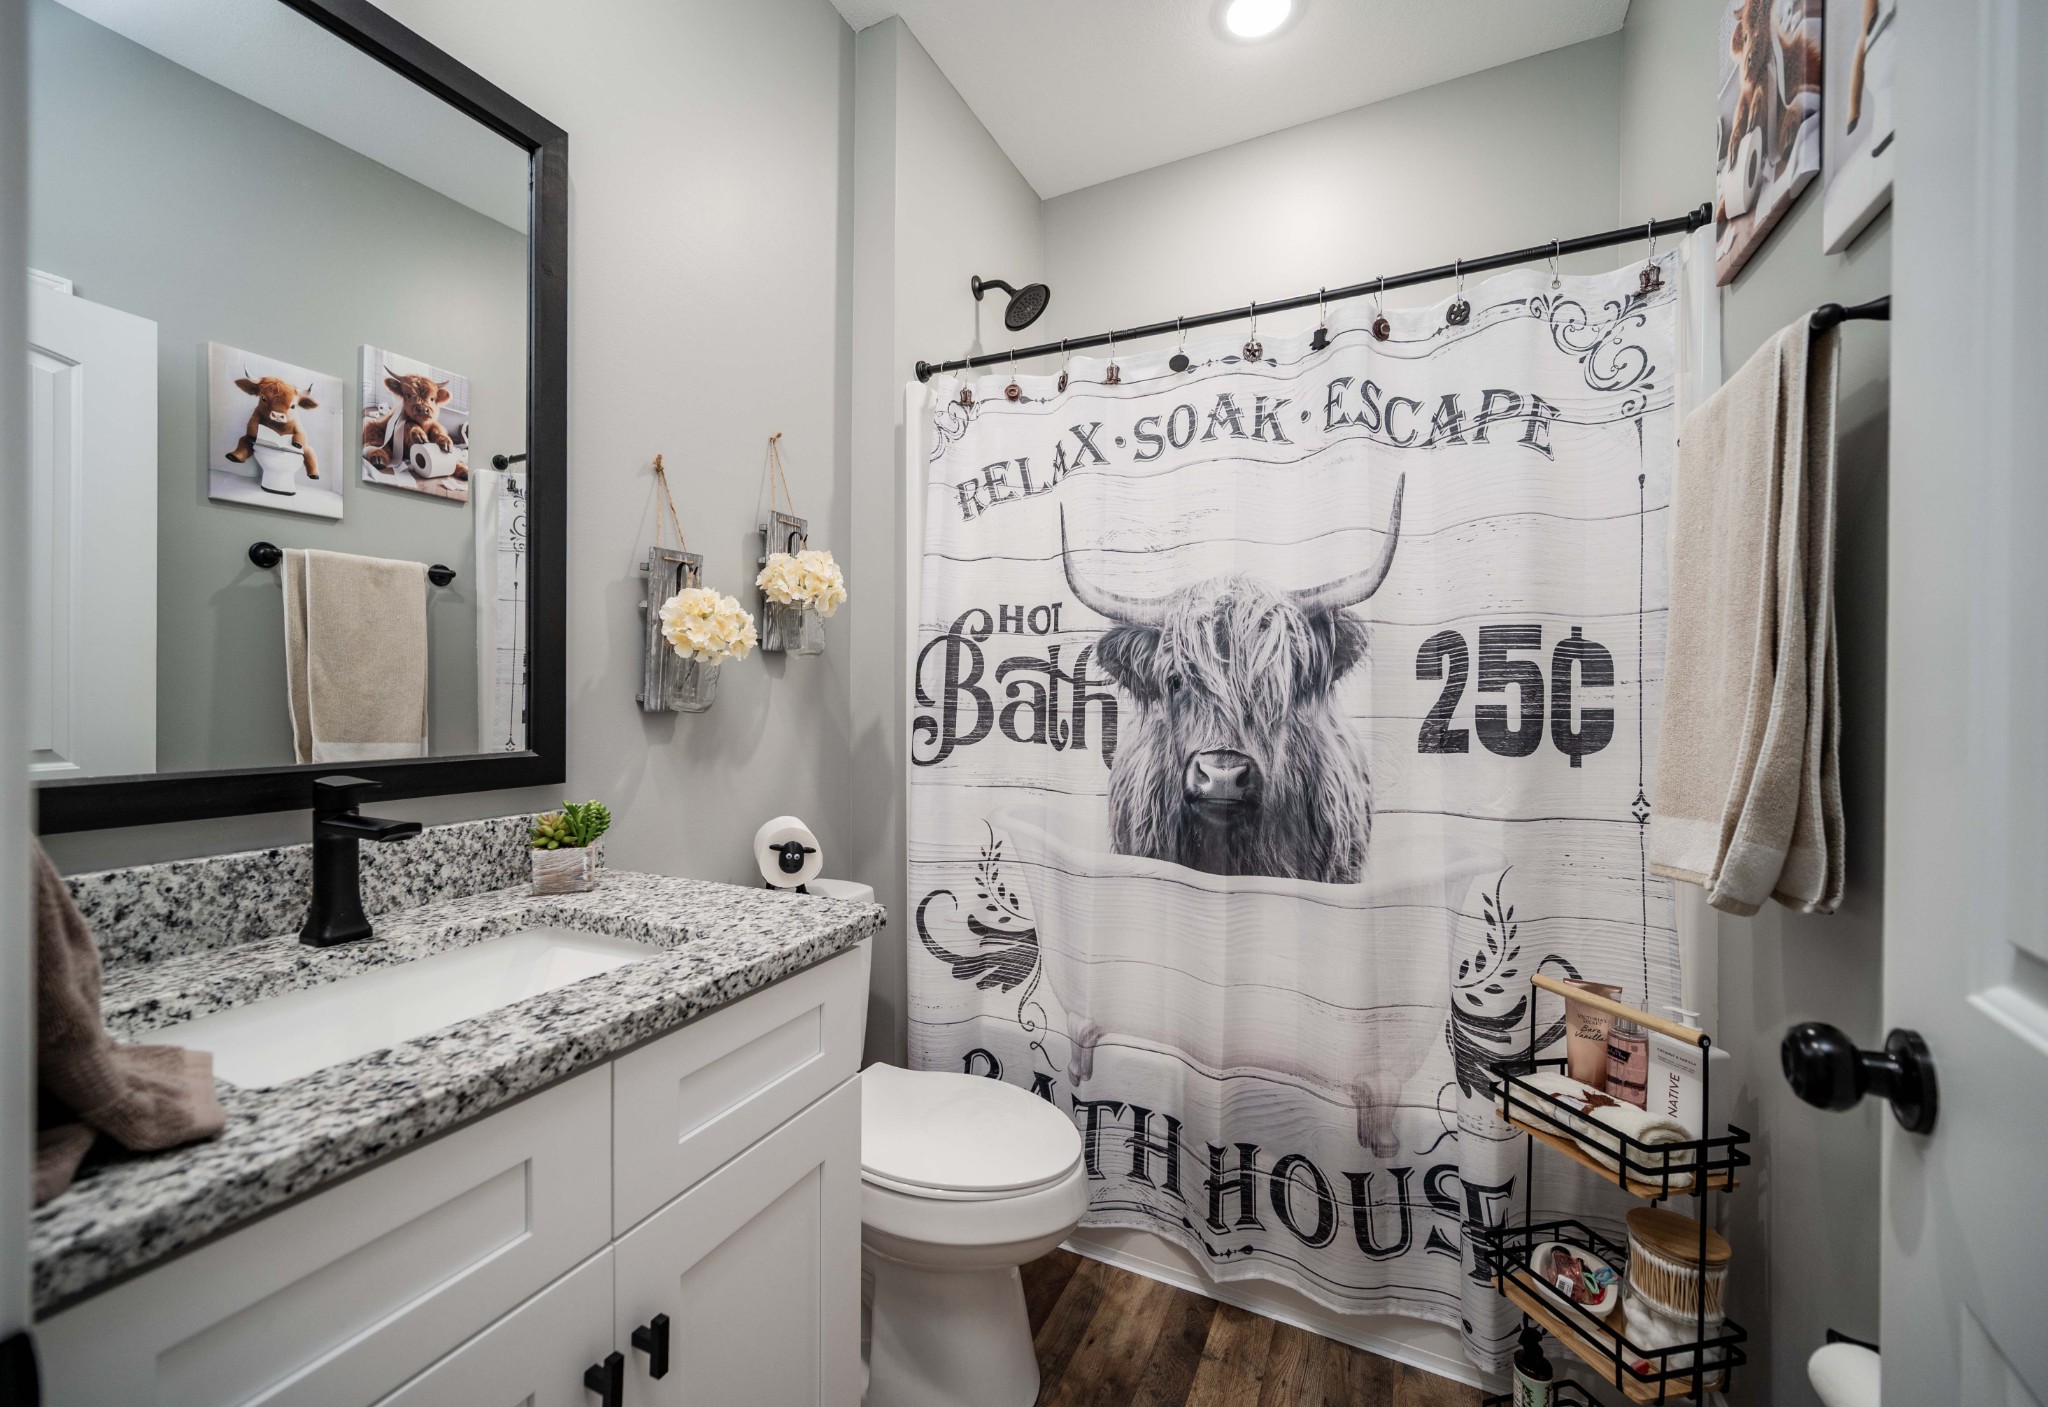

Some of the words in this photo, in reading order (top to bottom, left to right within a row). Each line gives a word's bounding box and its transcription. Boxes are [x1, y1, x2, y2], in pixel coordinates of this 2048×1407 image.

[955, 421, 1110, 522] RELAX
[1133, 392, 1295, 463] SOAK
[1322, 376, 1561, 462] ESCAPE
[998, 602, 1063, 635] HOT
[911, 607, 1119, 771] Bath
[1574, 1030, 1608, 1042] Vanilla
[1580, 1024, 1602, 1034] Bare
[1667, 1072, 1680, 1118] NATIVE
